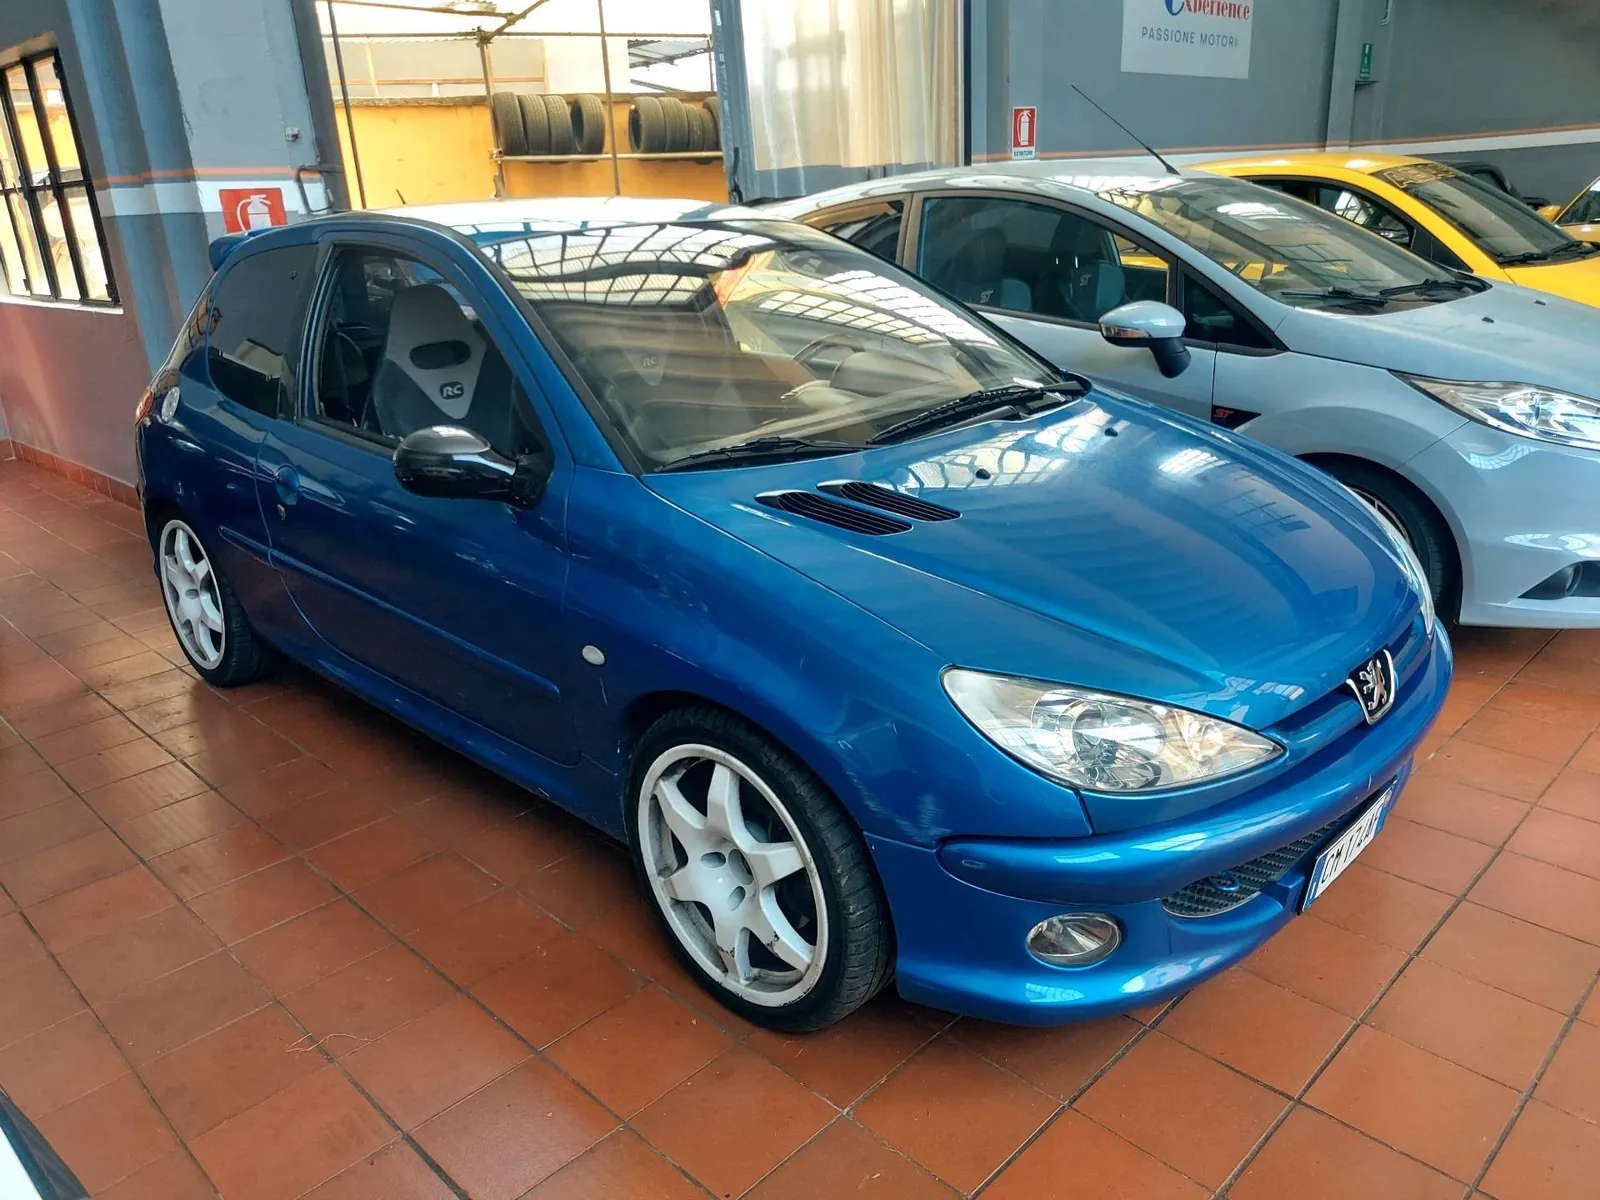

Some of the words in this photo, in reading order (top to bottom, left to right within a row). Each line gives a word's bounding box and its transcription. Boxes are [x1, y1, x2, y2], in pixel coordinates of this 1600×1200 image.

[1141, 26, 1196, 44] PASSIONE
[1200, 33, 1238, 48] MOTORI
[442, 384, 462, 398] RC
